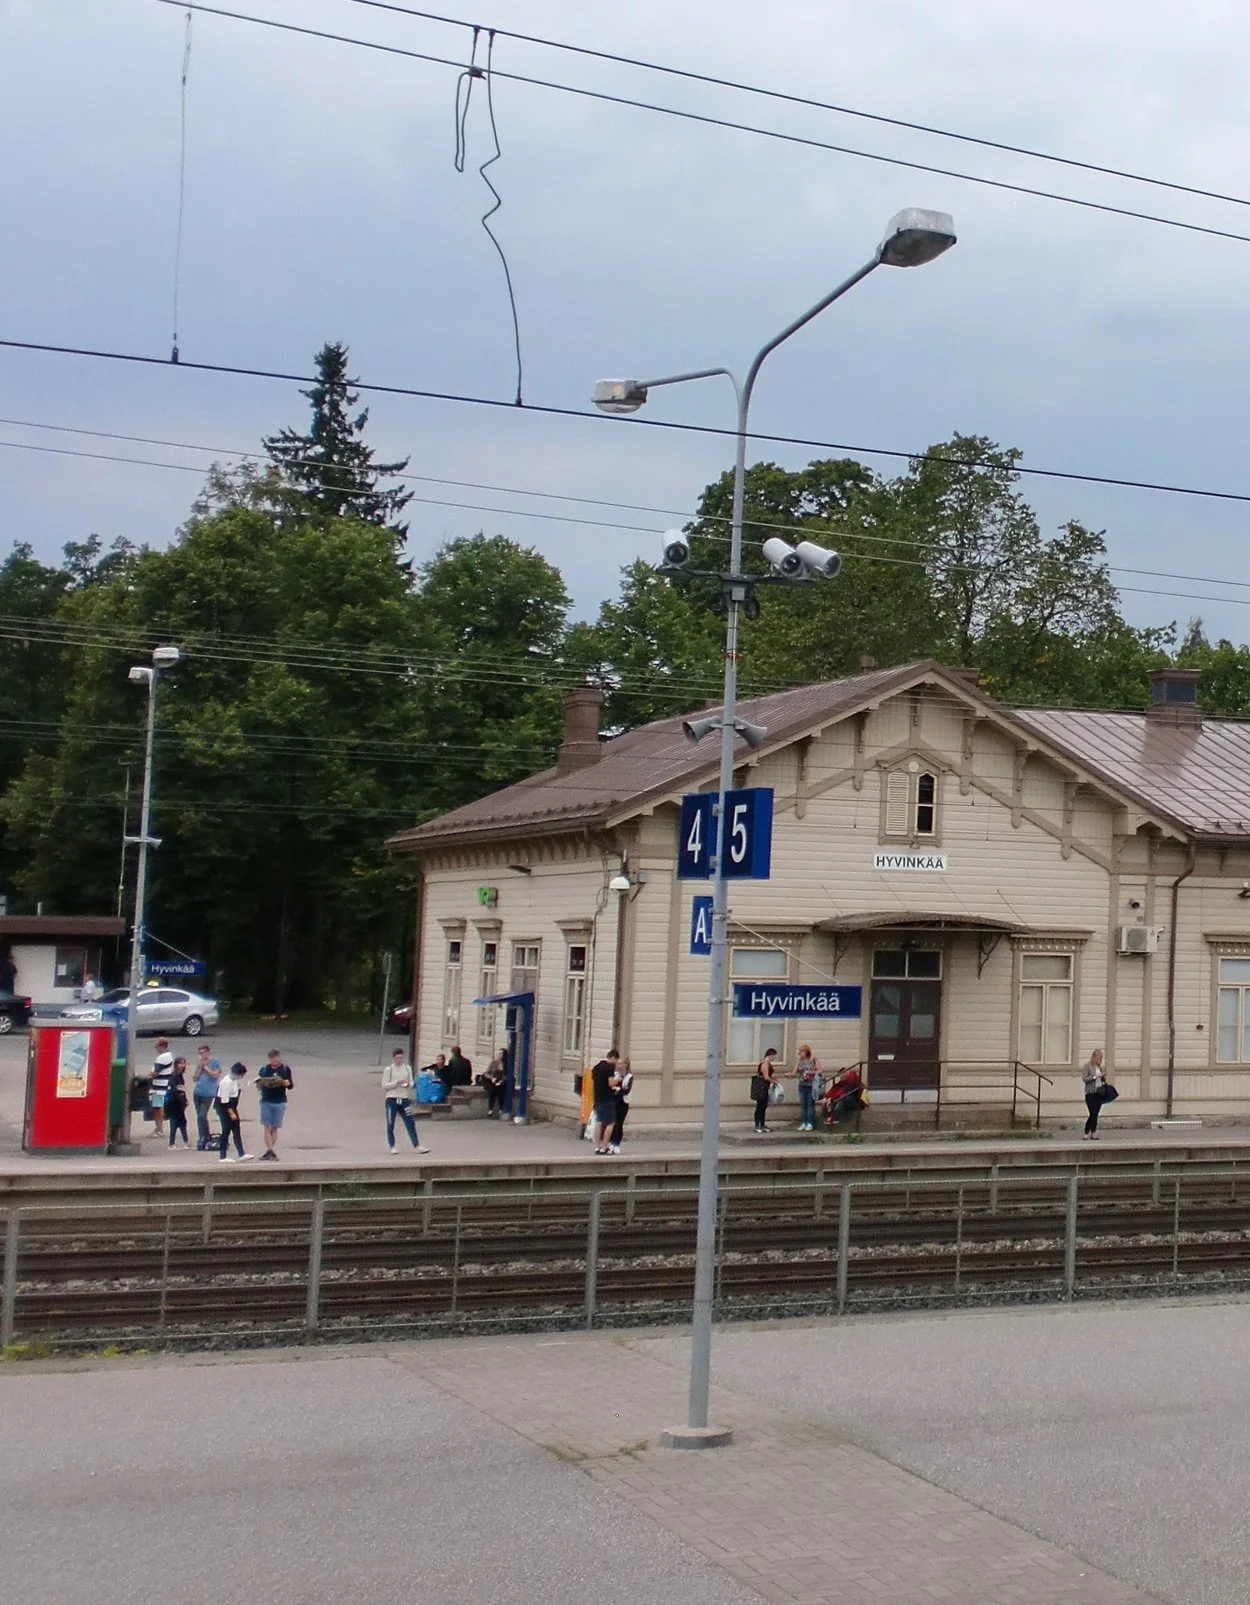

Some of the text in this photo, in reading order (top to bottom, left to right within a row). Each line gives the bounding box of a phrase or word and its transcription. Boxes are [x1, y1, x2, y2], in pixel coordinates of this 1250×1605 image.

[687, 809, 702, 864] 4
[731, 804, 747, 863] 5
[876, 855, 944, 869] HYVINKÄÄ
[694, 907, 707, 944] A
[151, 964, 195, 975] Hyvinkää
[751, 991, 840, 1015] Hyvinkää
